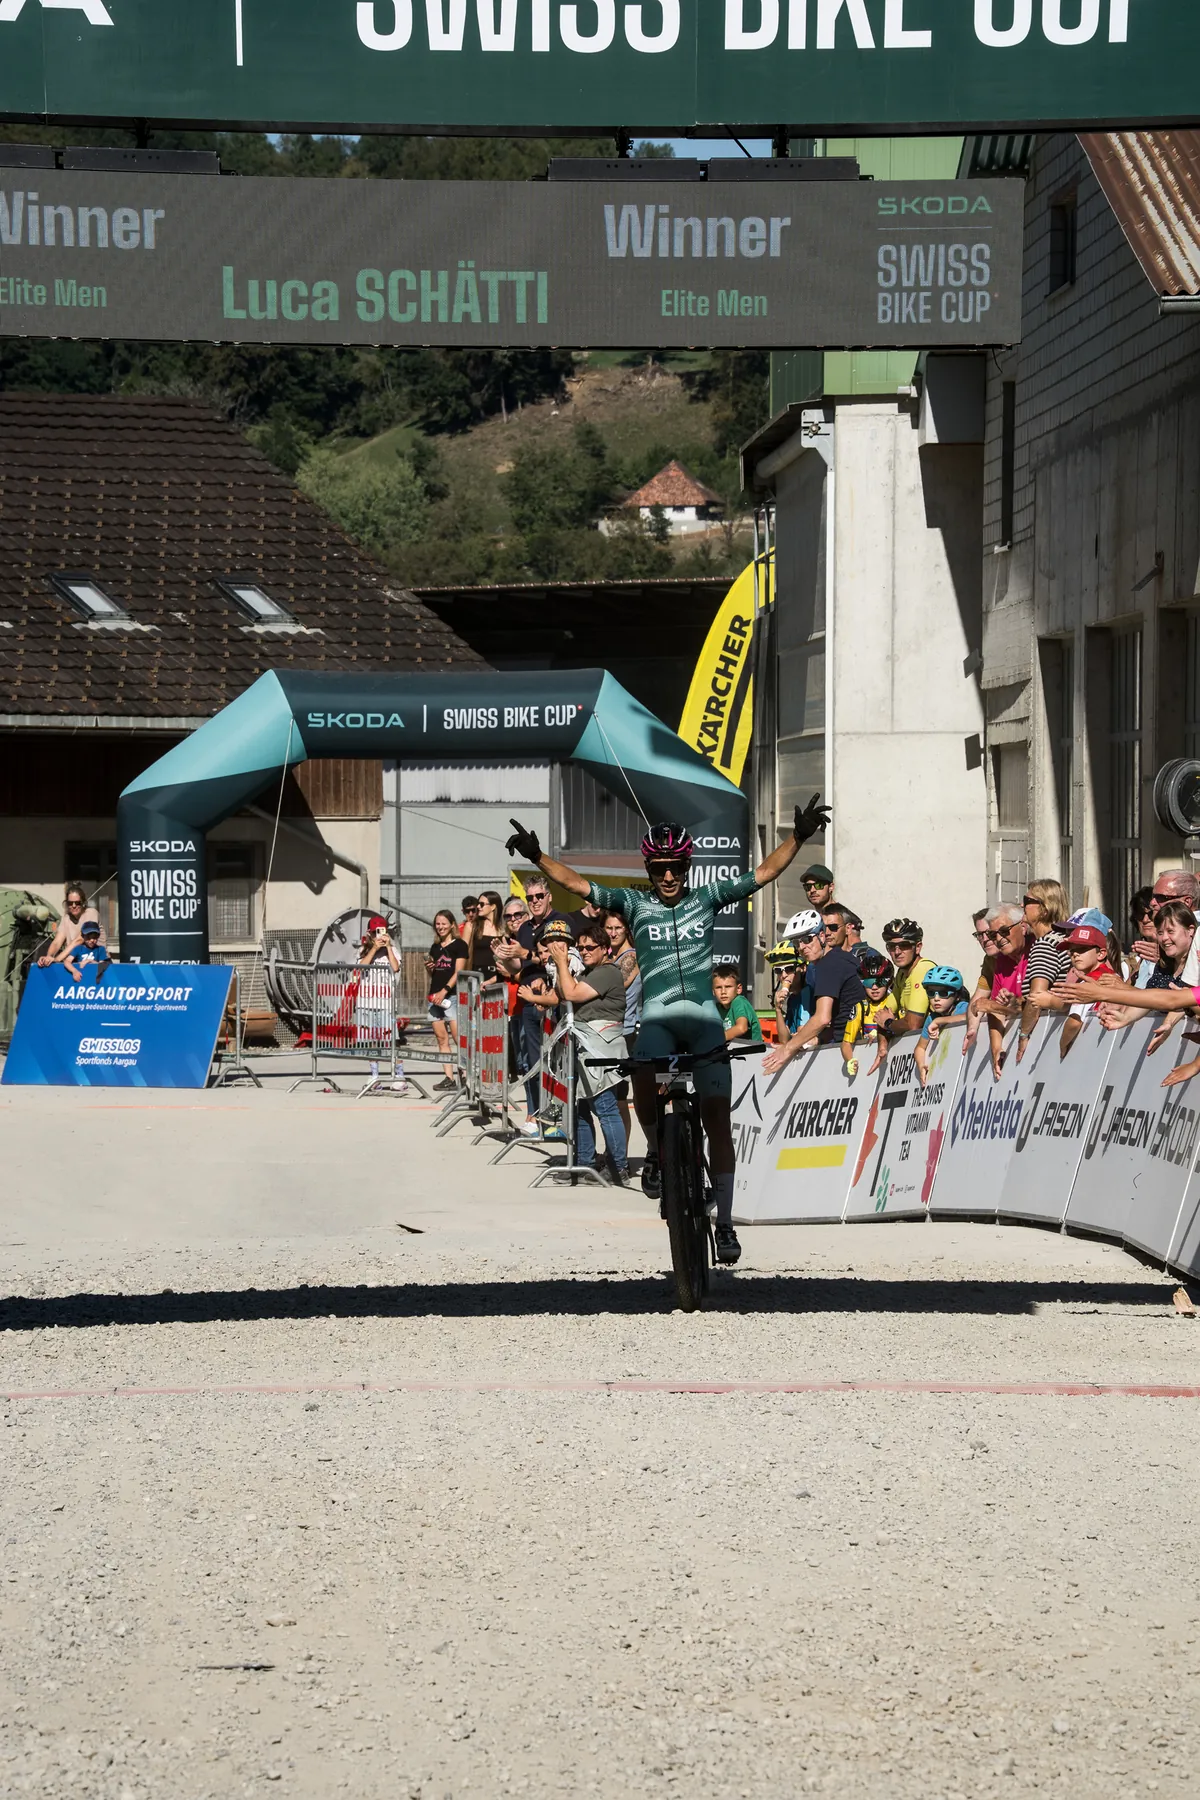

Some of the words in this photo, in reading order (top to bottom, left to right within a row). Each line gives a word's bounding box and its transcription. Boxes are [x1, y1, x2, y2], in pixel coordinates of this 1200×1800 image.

[603, 204, 792, 258] Winner
[877, 243, 991, 288] SWISS
[54, 279, 108, 308] Men
[222, 265, 339, 321] Luca
[355, 260, 548, 324] SCHÄTTI
[661, 289, 710, 317] Elite
[717, 289, 768, 317] Men
[877, 292, 933, 324] BIKE
[941, 290, 991, 323] CUP
[696, 614, 752, 764] KÄRCHER
[443, 707, 498, 730] SWISS
[504, 706, 540, 728] BIKE
[544, 704, 578, 726] CUP
[692, 836, 741, 849] KODA
[130, 869, 197, 897] SWISS
[132, 898, 165, 919] BIKE
[169, 898, 198, 919] CUP
[648, 921, 705, 941] BIXS
[51, 1002, 85, 1011] Vereinigung
[85, 1003, 127, 1011] bedeutendster
[127, 1003, 153, 1012] Aargauer
[80, 1039, 140, 1053] SWISSLOS
[75, 1056, 112, 1066] Sportfonds
[113, 1056, 137, 1067] Aargau
[668, 1055, 679, 1073] 2
[911, 1088, 924, 1108] THE
[923, 1083, 945, 1107] SWISS
[784, 1097, 858, 1139] KÄRCHER
[904, 1111, 932, 1136] VITAMIN
[961, 1080, 1024, 1141] helvetia
[1032, 1101, 1090, 1139] JAISON
[1101, 1106, 1156, 1149] JAISON
[899, 1140, 911, 1161] TEA
